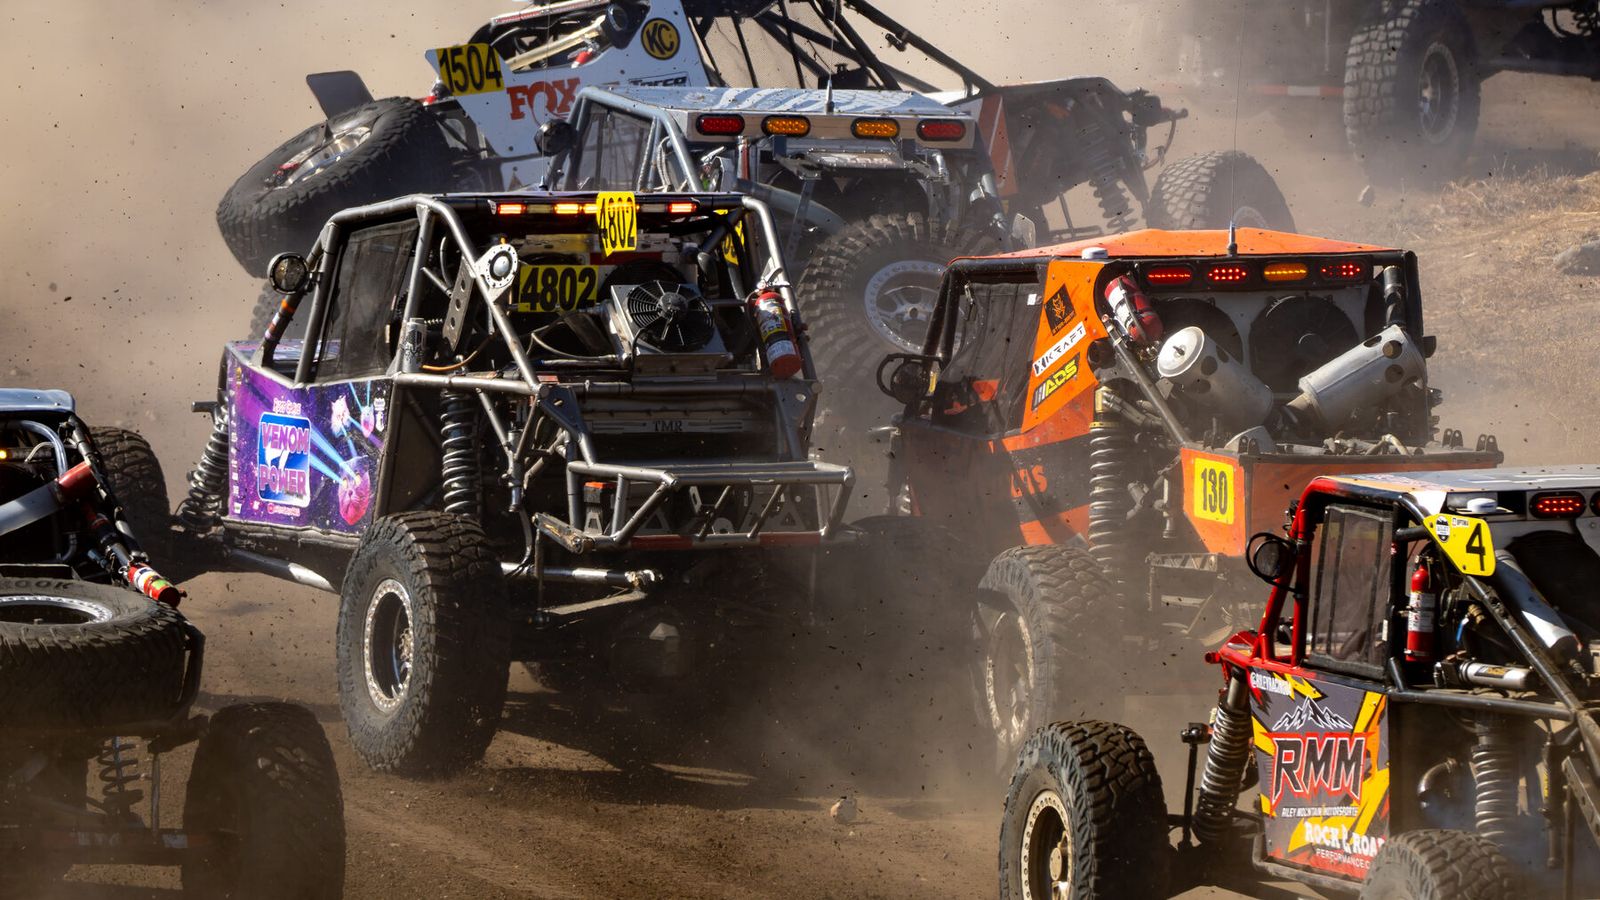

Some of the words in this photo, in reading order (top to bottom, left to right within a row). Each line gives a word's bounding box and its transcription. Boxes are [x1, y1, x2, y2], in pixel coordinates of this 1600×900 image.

[648, 20, 675, 57] KC
[439, 47, 502, 94] 1504
[506, 77, 581, 123] FOX
[598, 196, 636, 250] 4802
[521, 267, 597, 311] 4802
[1044, 359, 1078, 397] ADS
[262, 422, 309, 455] VENOM
[259, 464, 307, 495] POWER
[1201, 467, 1228, 515] 130
[1466, 523, 1486, 571] 4
[1271, 736, 1366, 807] RMM
[1303, 821, 1341, 847] ROCK
